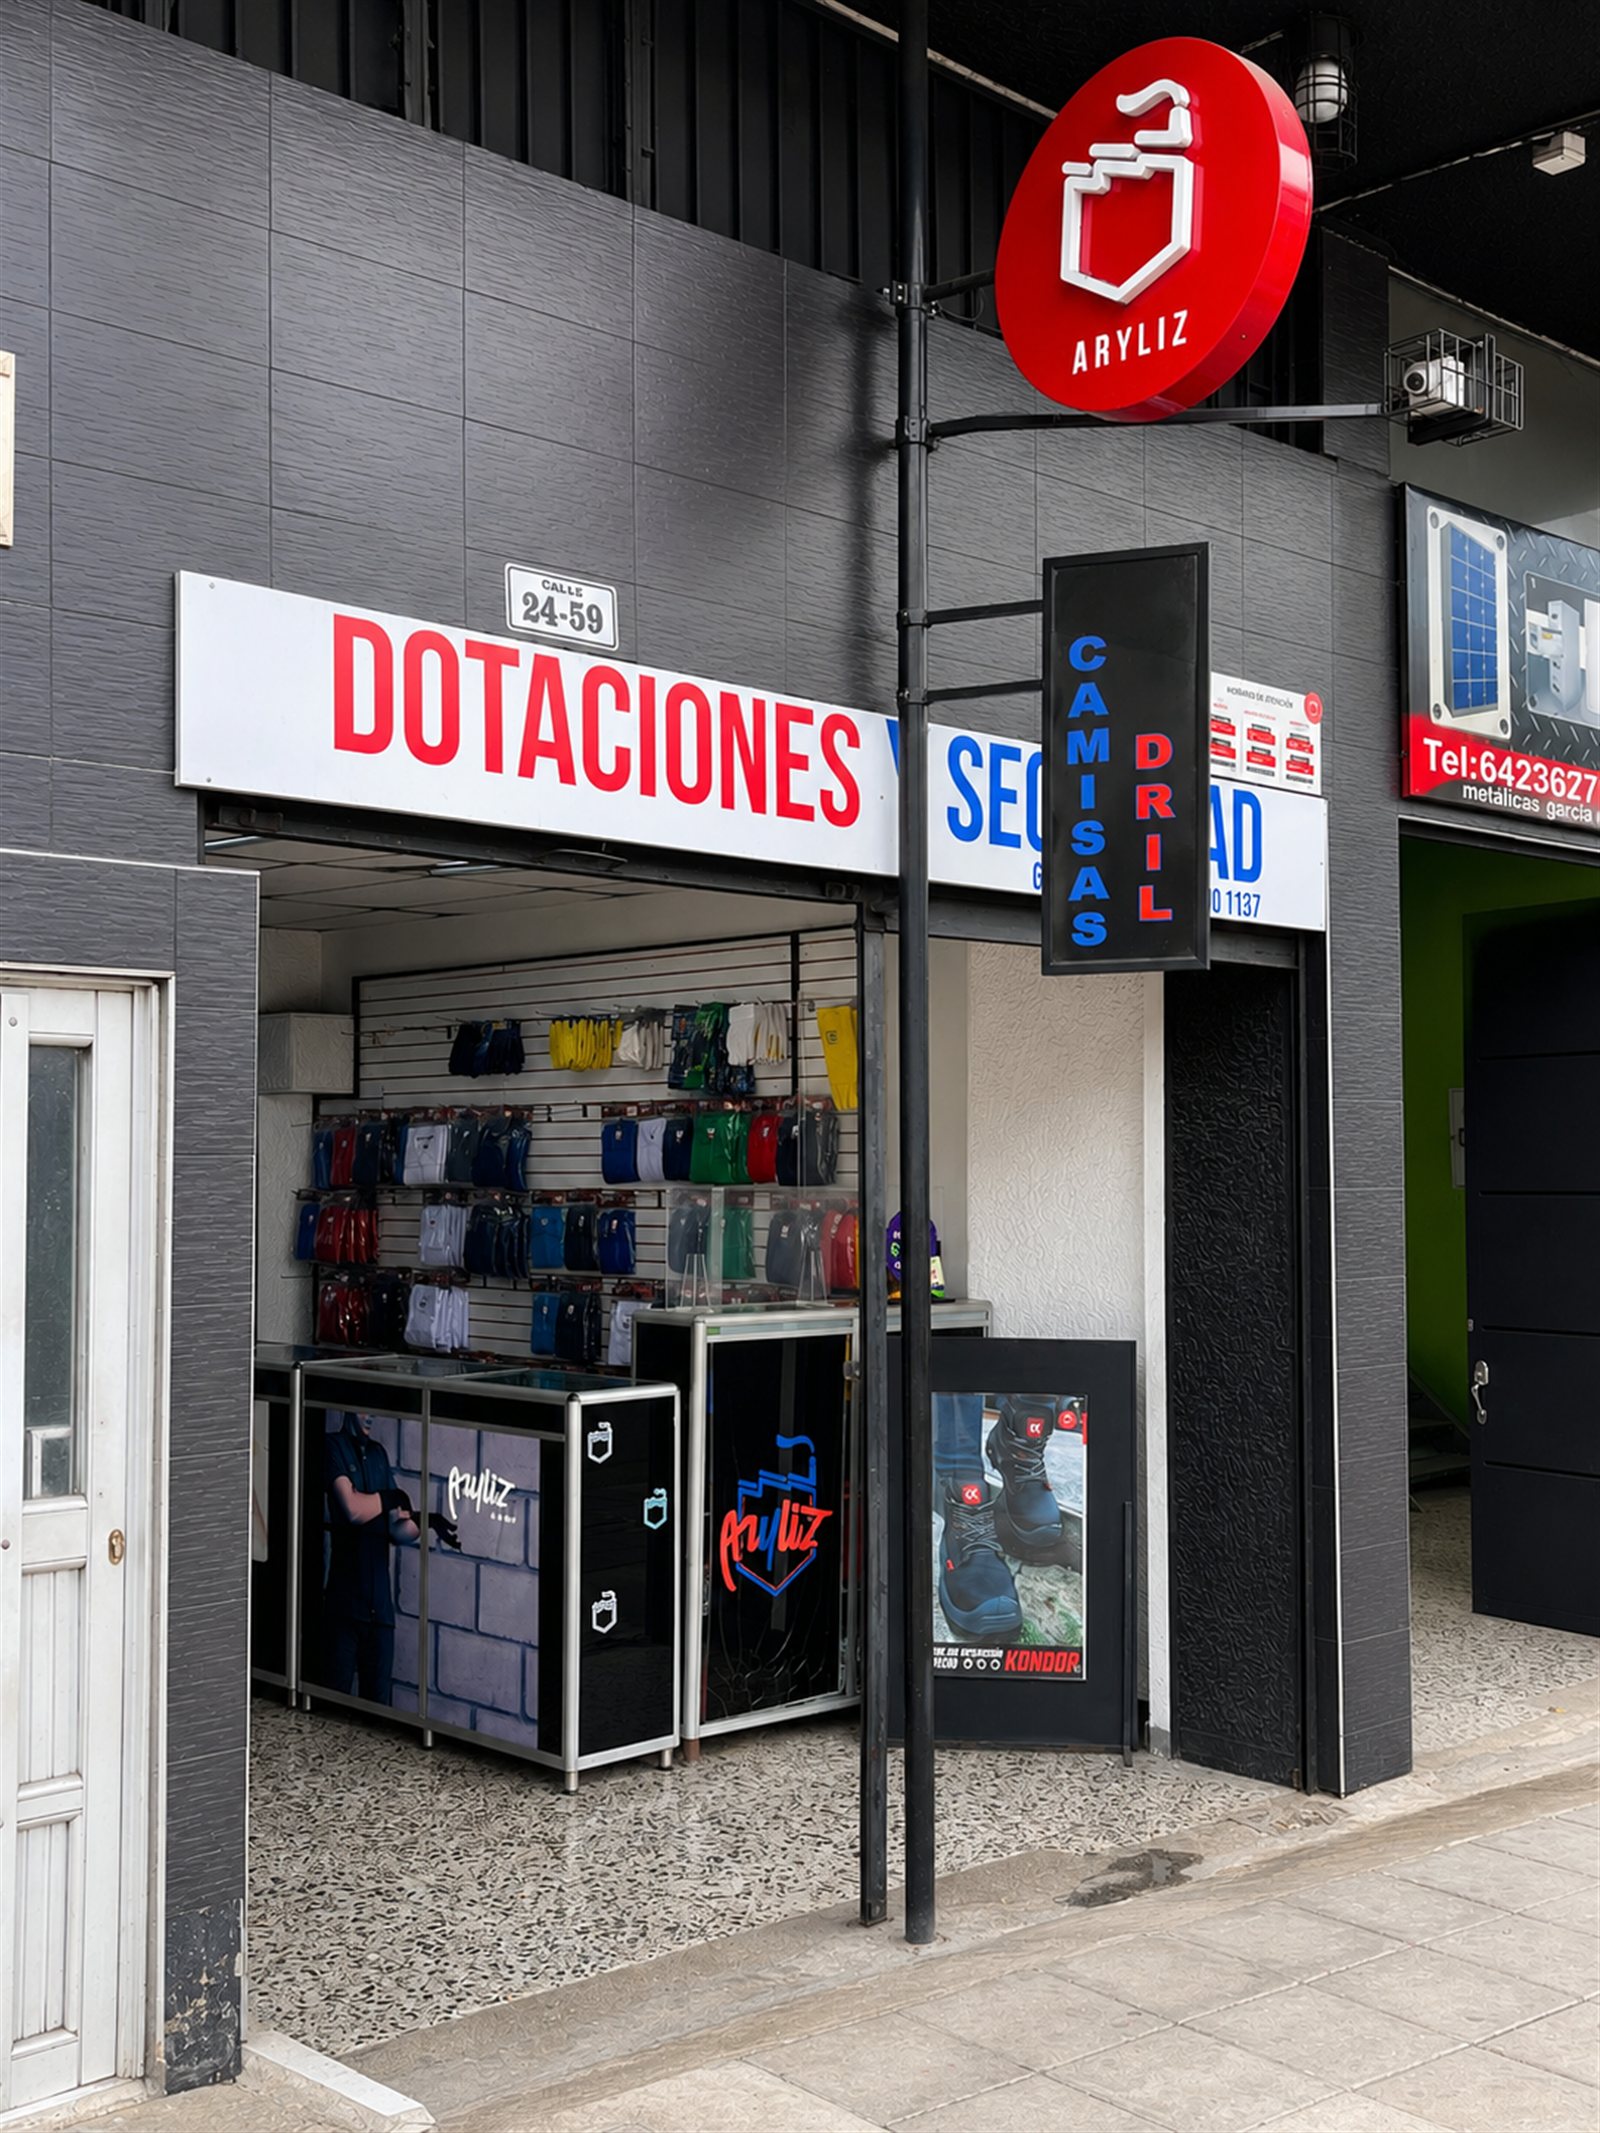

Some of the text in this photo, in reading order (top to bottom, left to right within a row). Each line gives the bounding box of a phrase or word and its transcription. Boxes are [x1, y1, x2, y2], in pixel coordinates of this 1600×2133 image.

[1072, 310, 1189, 376] ARYLIZ
[522, 591, 603, 634] 24-59
[541, 579, 584, 598] CALLE
[333, 613, 862, 828] DOTACIONES
[1066, 635, 1110, 947] CAMISAS
[1423, 738, 1598, 804] Tel:6423627
[1135, 733, 1176, 922] DRIL
[1226, 890, 1261, 918] 1137
[1004, 1649, 1081, 1673] KONDOR
